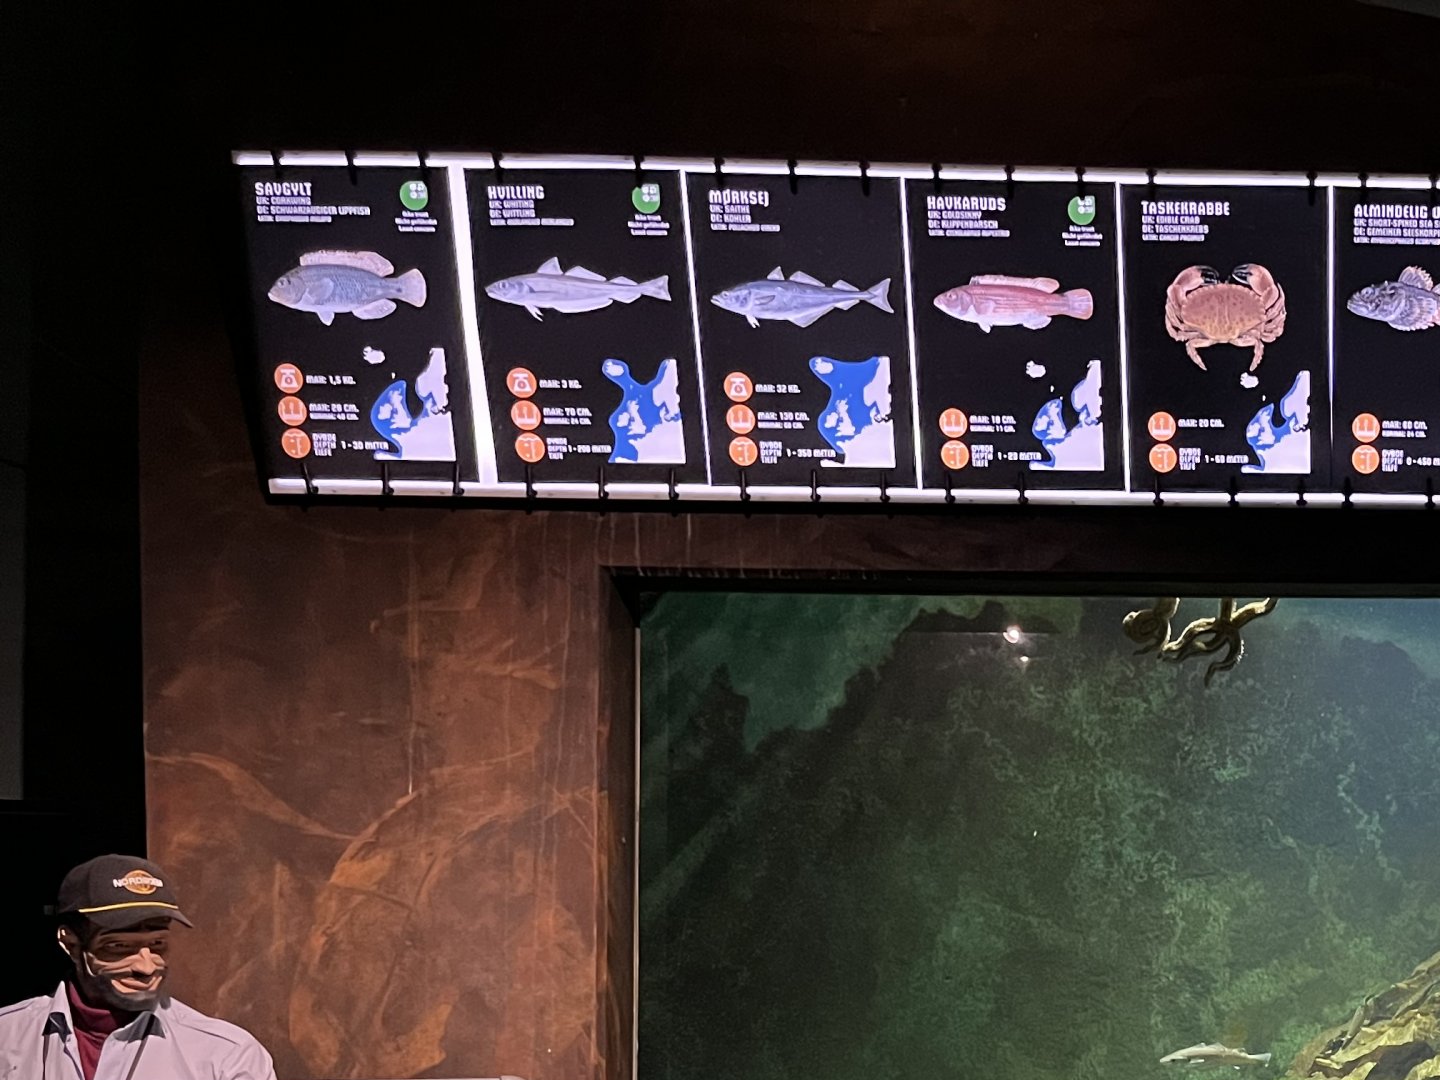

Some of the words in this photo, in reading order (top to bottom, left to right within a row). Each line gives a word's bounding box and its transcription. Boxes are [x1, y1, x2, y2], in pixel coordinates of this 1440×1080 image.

[255, 182, 312, 196] SAVGYLT
[488, 186, 545, 199] HVILLING
[709, 189, 769, 207] MØRKSEJ
[927, 196, 1006, 211] HAVKARUDS
[1141, 201, 1230, 215] TASKEKRABBE
[1354, 204, 1428, 218] ALMINDELIG
[1142, 216, 1155, 224] UK:
[1156, 216, 1179, 224] EDIBLE
[1180, 216, 1200, 224] CRAB
[1354, 218, 1367, 228] UK:
[1419, 218, 1433, 228] SEA
[1142, 225, 1155, 233] DE:
[1354, 227, 1366, 237] DE:
